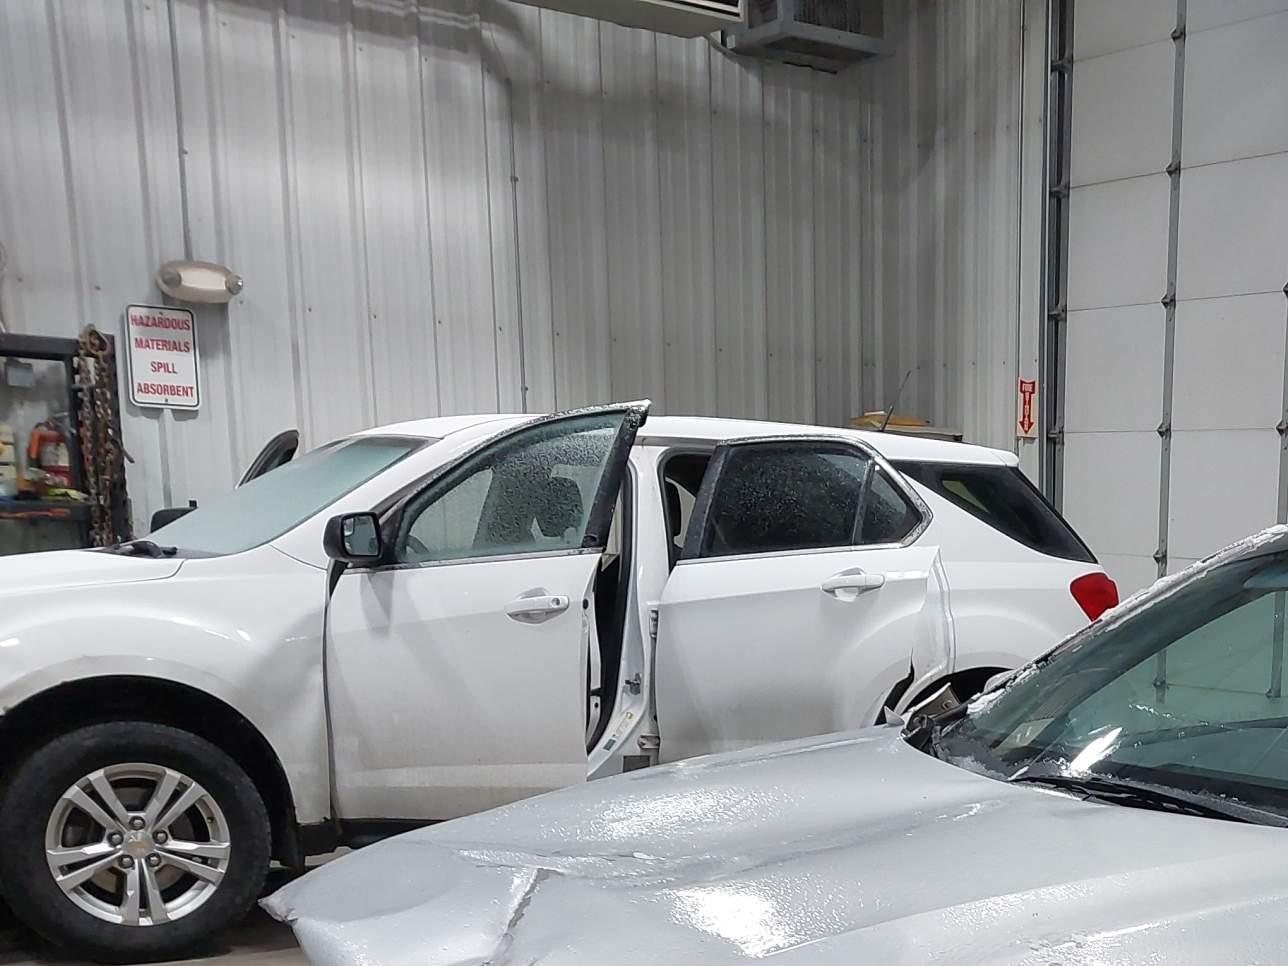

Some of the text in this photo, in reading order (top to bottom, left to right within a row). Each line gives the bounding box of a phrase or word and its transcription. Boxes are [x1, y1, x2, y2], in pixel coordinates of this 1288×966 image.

[131, 314, 190, 330] HAZARDOUS
[135, 338, 190, 352] MATERIALS
[150, 361, 178, 374] SPILL
[137, 383, 194, 397] ABSORBENT
